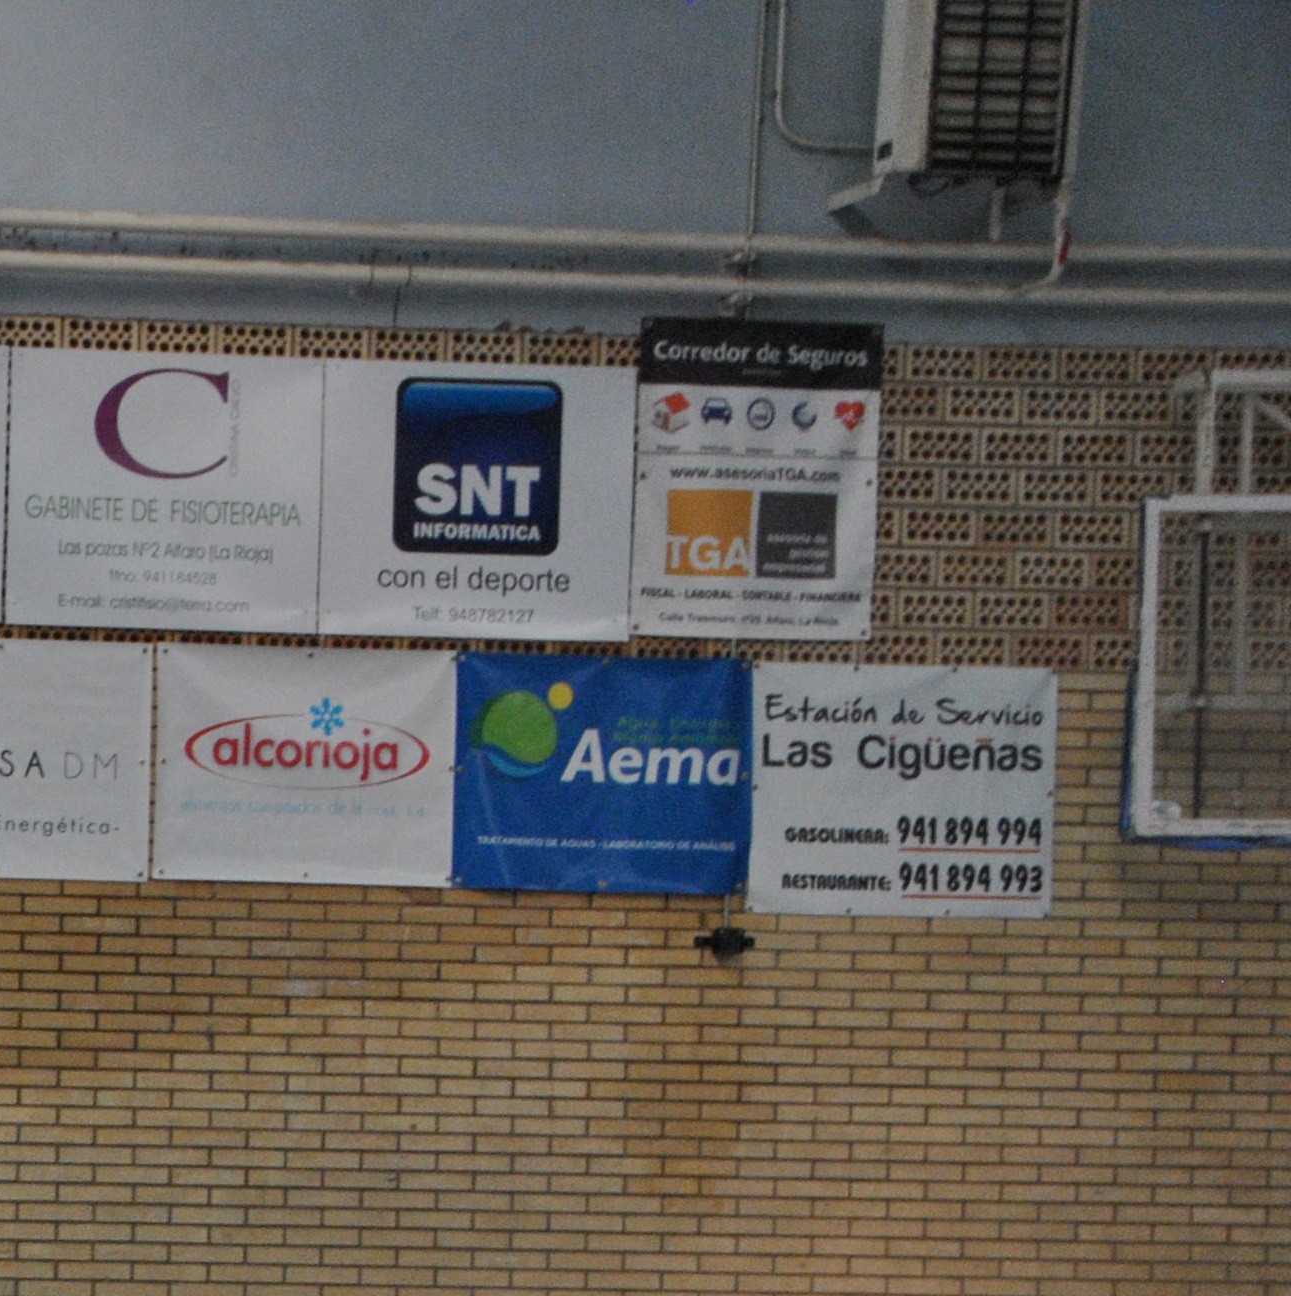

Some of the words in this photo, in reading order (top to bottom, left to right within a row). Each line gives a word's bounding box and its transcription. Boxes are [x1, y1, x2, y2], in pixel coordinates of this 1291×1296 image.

[653, 340, 750, 364] Corredor
[756, 343, 781, 364] de
[788, 344, 868, 371] Seguros
[94, 368, 230, 479] C
[414, 462, 541, 518] SNT
[25, 494, 123, 521] GABINETE
[131, 499, 158, 522] DE
[170, 499, 301, 527] FISIOTERAPIA
[413, 522, 541, 542] INFORMATICA
[58, 539, 81, 556] Las
[164, 541, 205, 560] Alfaro
[666, 535, 749, 571] TGA
[377, 567, 425, 589] con
[435, 566, 458, 590] el
[467, 566, 570, 597] deporte
[641, 587, 675, 599] FISCAL
[684, 589, 733, 600] LABORAL
[764, 694, 877, 724] Estación
[891, 698, 925, 725] de
[936, 697, 1044, 727] Servicio
[63, 752, 119, 779] DM
[213, 722, 399, 781] alcorioja
[560, 728, 741, 786] Aema
[762, 733, 833, 769] Las
[857, 735, 1044, 780] Cigüeñas
[477, 835, 543, 847] TRATAMIENTO
[545, 837, 559, 848] DE
[561, 838, 596, 849] AGUAS
[602, 839, 675, 850] LABORATORIO
[677, 840, 690, 850] DE
[785, 826, 890, 845] GASOLINERA:
[897, 815, 937, 846] 941
[944, 816, 989, 846] 894
[997, 816, 1042, 847] 994
[781, 873, 891, 892] RESTAURANTE:
[899, 862, 939, 892] 941
[946, 863, 991, 892] 894
[999, 864, 1044, 894] 993
